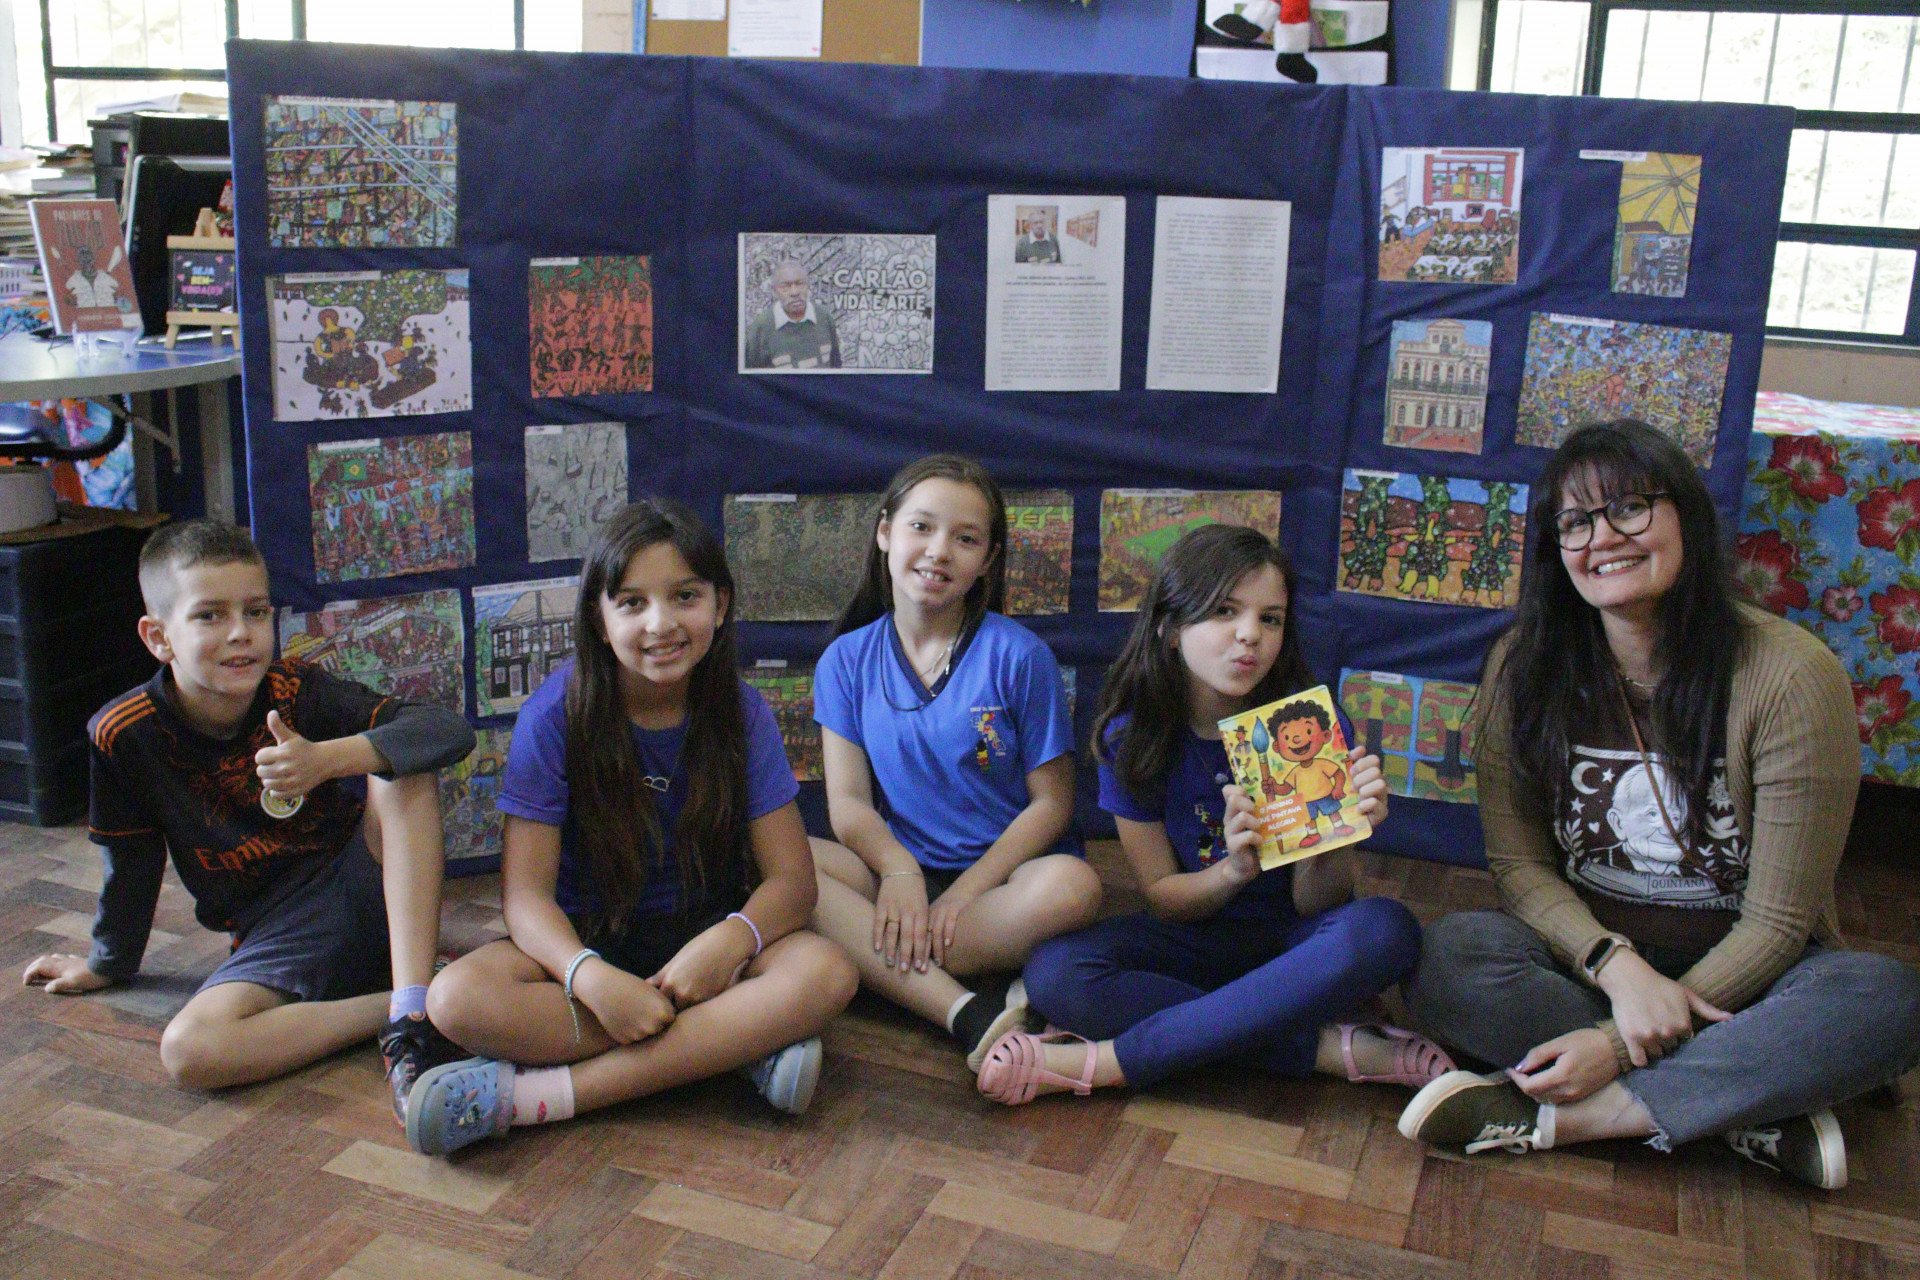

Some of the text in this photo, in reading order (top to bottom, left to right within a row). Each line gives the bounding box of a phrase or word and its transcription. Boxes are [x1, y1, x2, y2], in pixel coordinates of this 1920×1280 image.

[191, 266, 215, 275] SEJA
[833, 263, 928, 290] CARLÃO
[833, 294, 927, 311] VIDA E ARTE
[1267, 817, 1297, 831] ALEGRIA
[1651, 878, 1706, 889] QUINTANA
